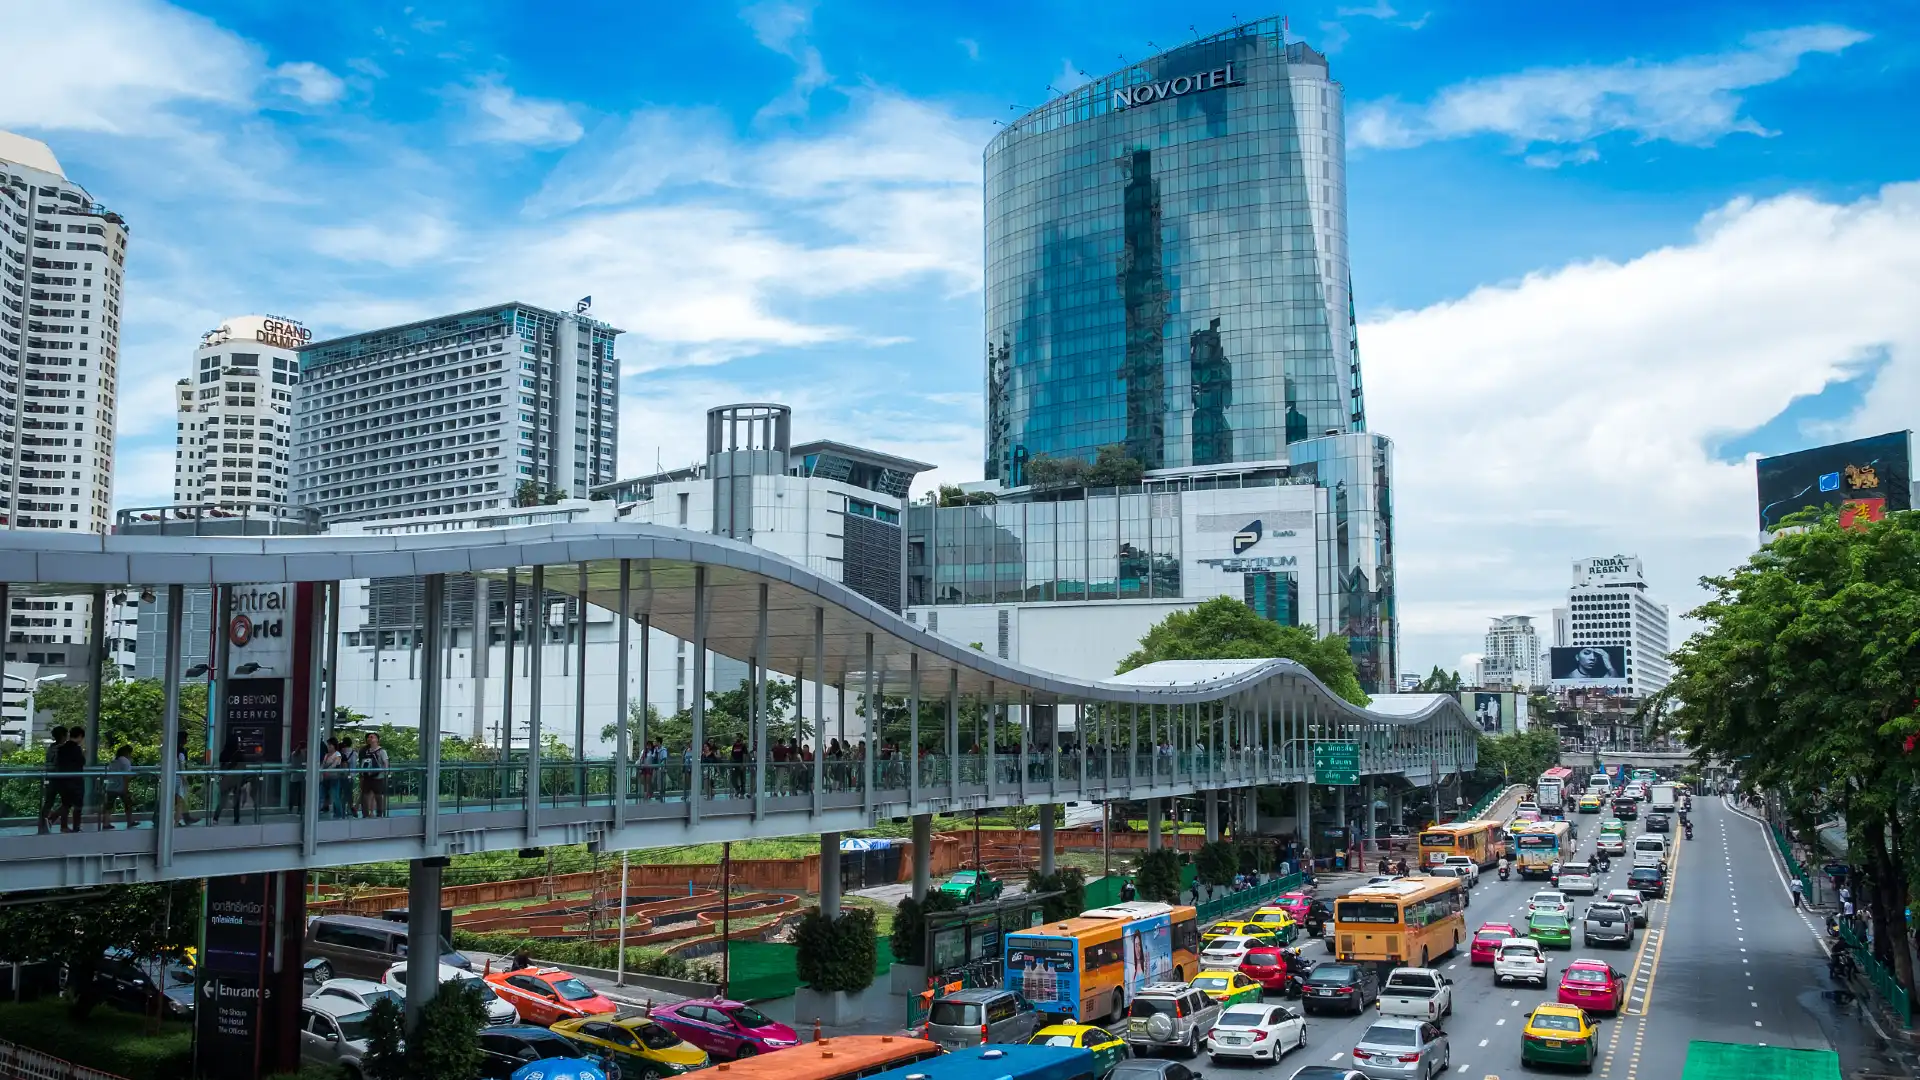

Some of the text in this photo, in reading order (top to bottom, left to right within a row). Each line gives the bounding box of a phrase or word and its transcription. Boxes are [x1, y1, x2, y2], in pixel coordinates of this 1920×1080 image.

[1113, 60, 1242, 111] NOVOTEL
[256, 329, 312, 348] DIAMO
[263, 319, 312, 341] GRAND
[1589, 565, 1629, 574] REGENT
[230, 587, 286, 611] entral
[228, 694, 278, 705] CB BEYOND
[229, 710, 278, 719] ESERVED
[220, 984, 271, 999] Entrance
